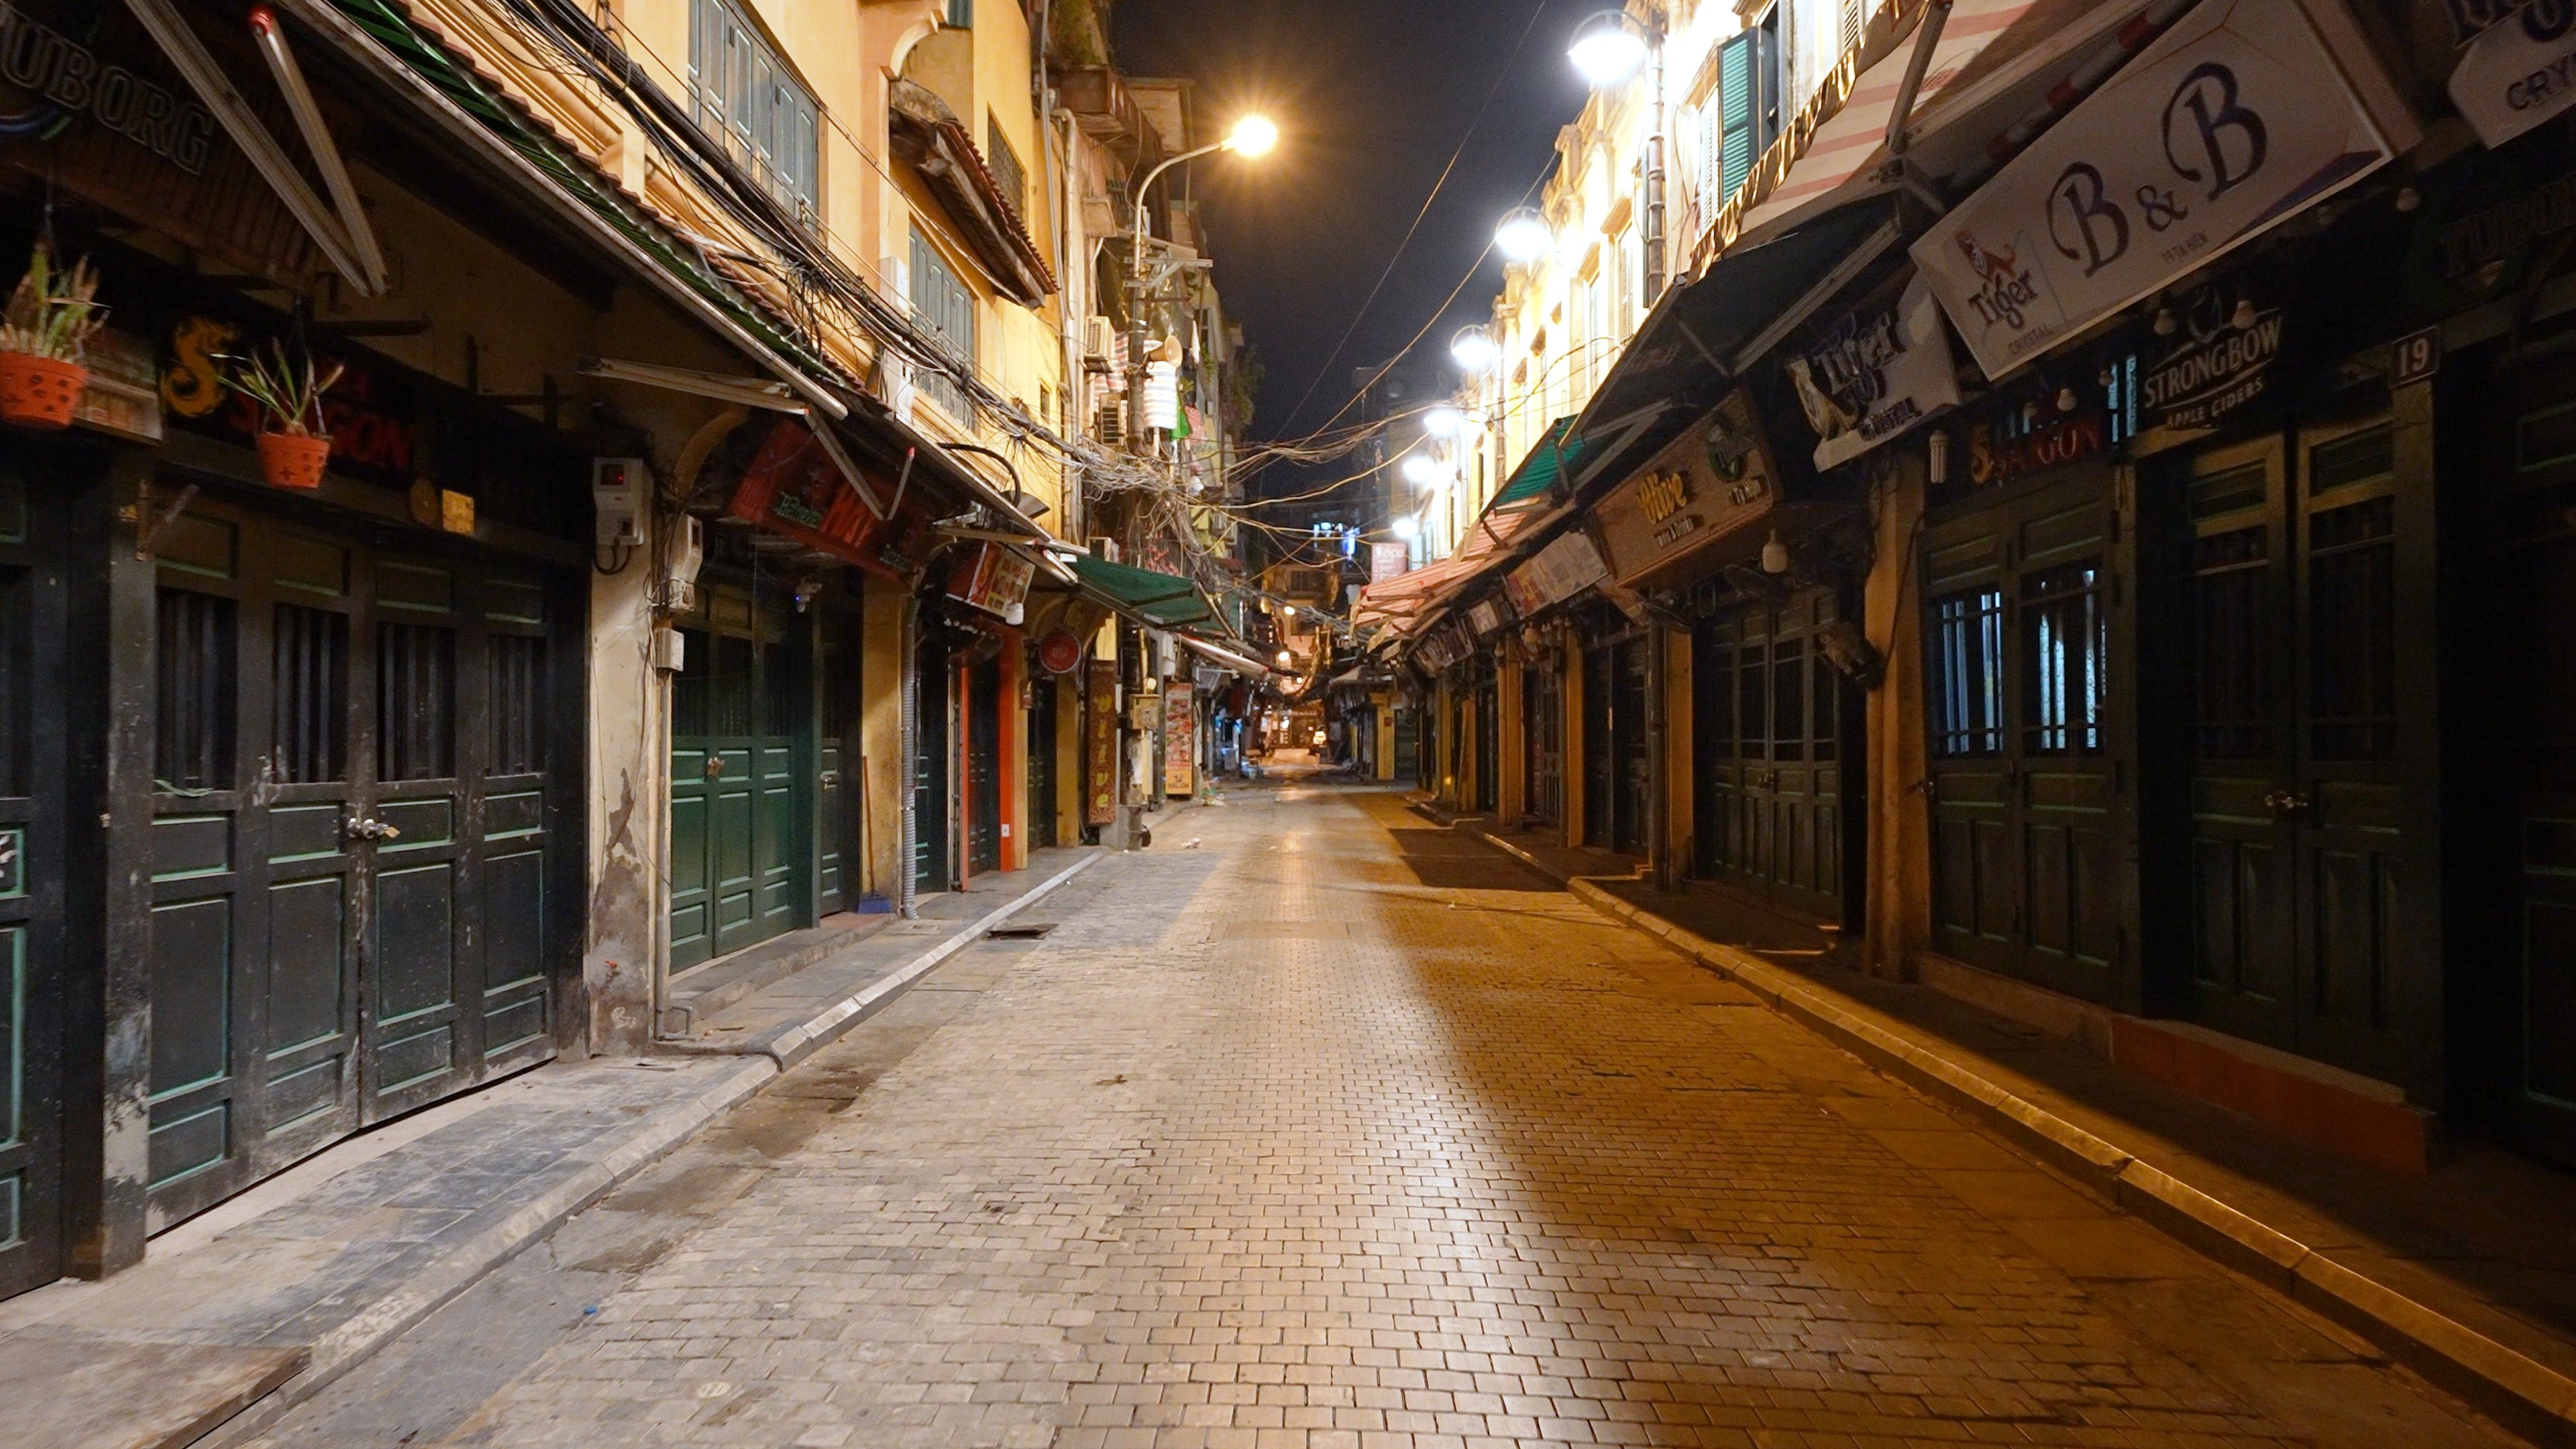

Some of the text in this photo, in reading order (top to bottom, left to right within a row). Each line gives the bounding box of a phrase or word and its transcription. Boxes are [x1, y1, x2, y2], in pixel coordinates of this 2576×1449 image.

[2046, 61, 2267, 278] B & B
[1967, 269, 2038, 329] Tiger
[2008, 325, 2053, 355] CRYSTAL
[2144, 315, 2282, 409] STRONGBOW
[2400, 337, 2428, 376] 19
[2166, 376, 2264, 428] APPLE CIDERS
